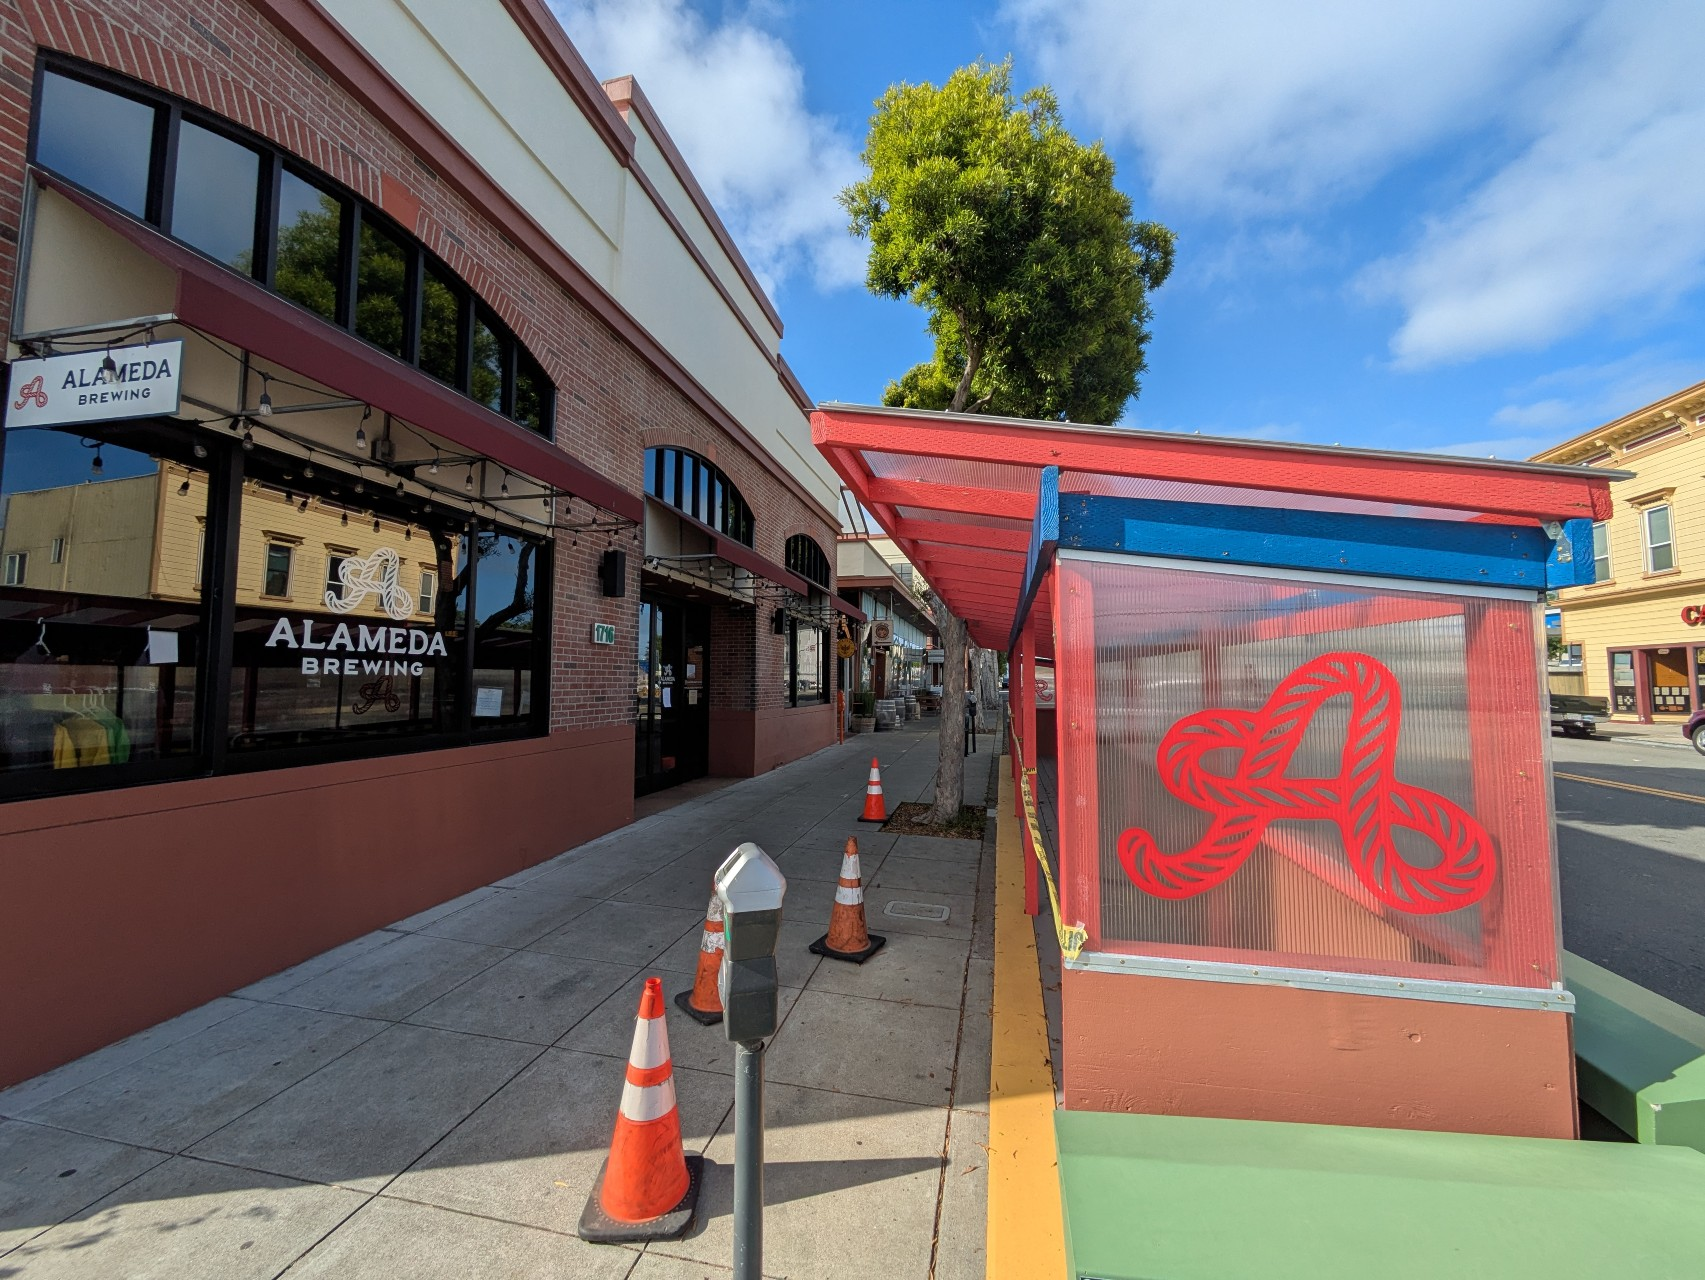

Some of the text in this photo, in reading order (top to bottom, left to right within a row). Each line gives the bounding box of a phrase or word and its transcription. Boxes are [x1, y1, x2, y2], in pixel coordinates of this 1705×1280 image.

[62, 359, 172, 389] ALAMEDA
[78, 387, 151, 406] BREWING
[265, 617, 448, 656] ALAMEDA
[596, 625, 615, 643] 1716
[301, 657, 424, 676] BREWING
